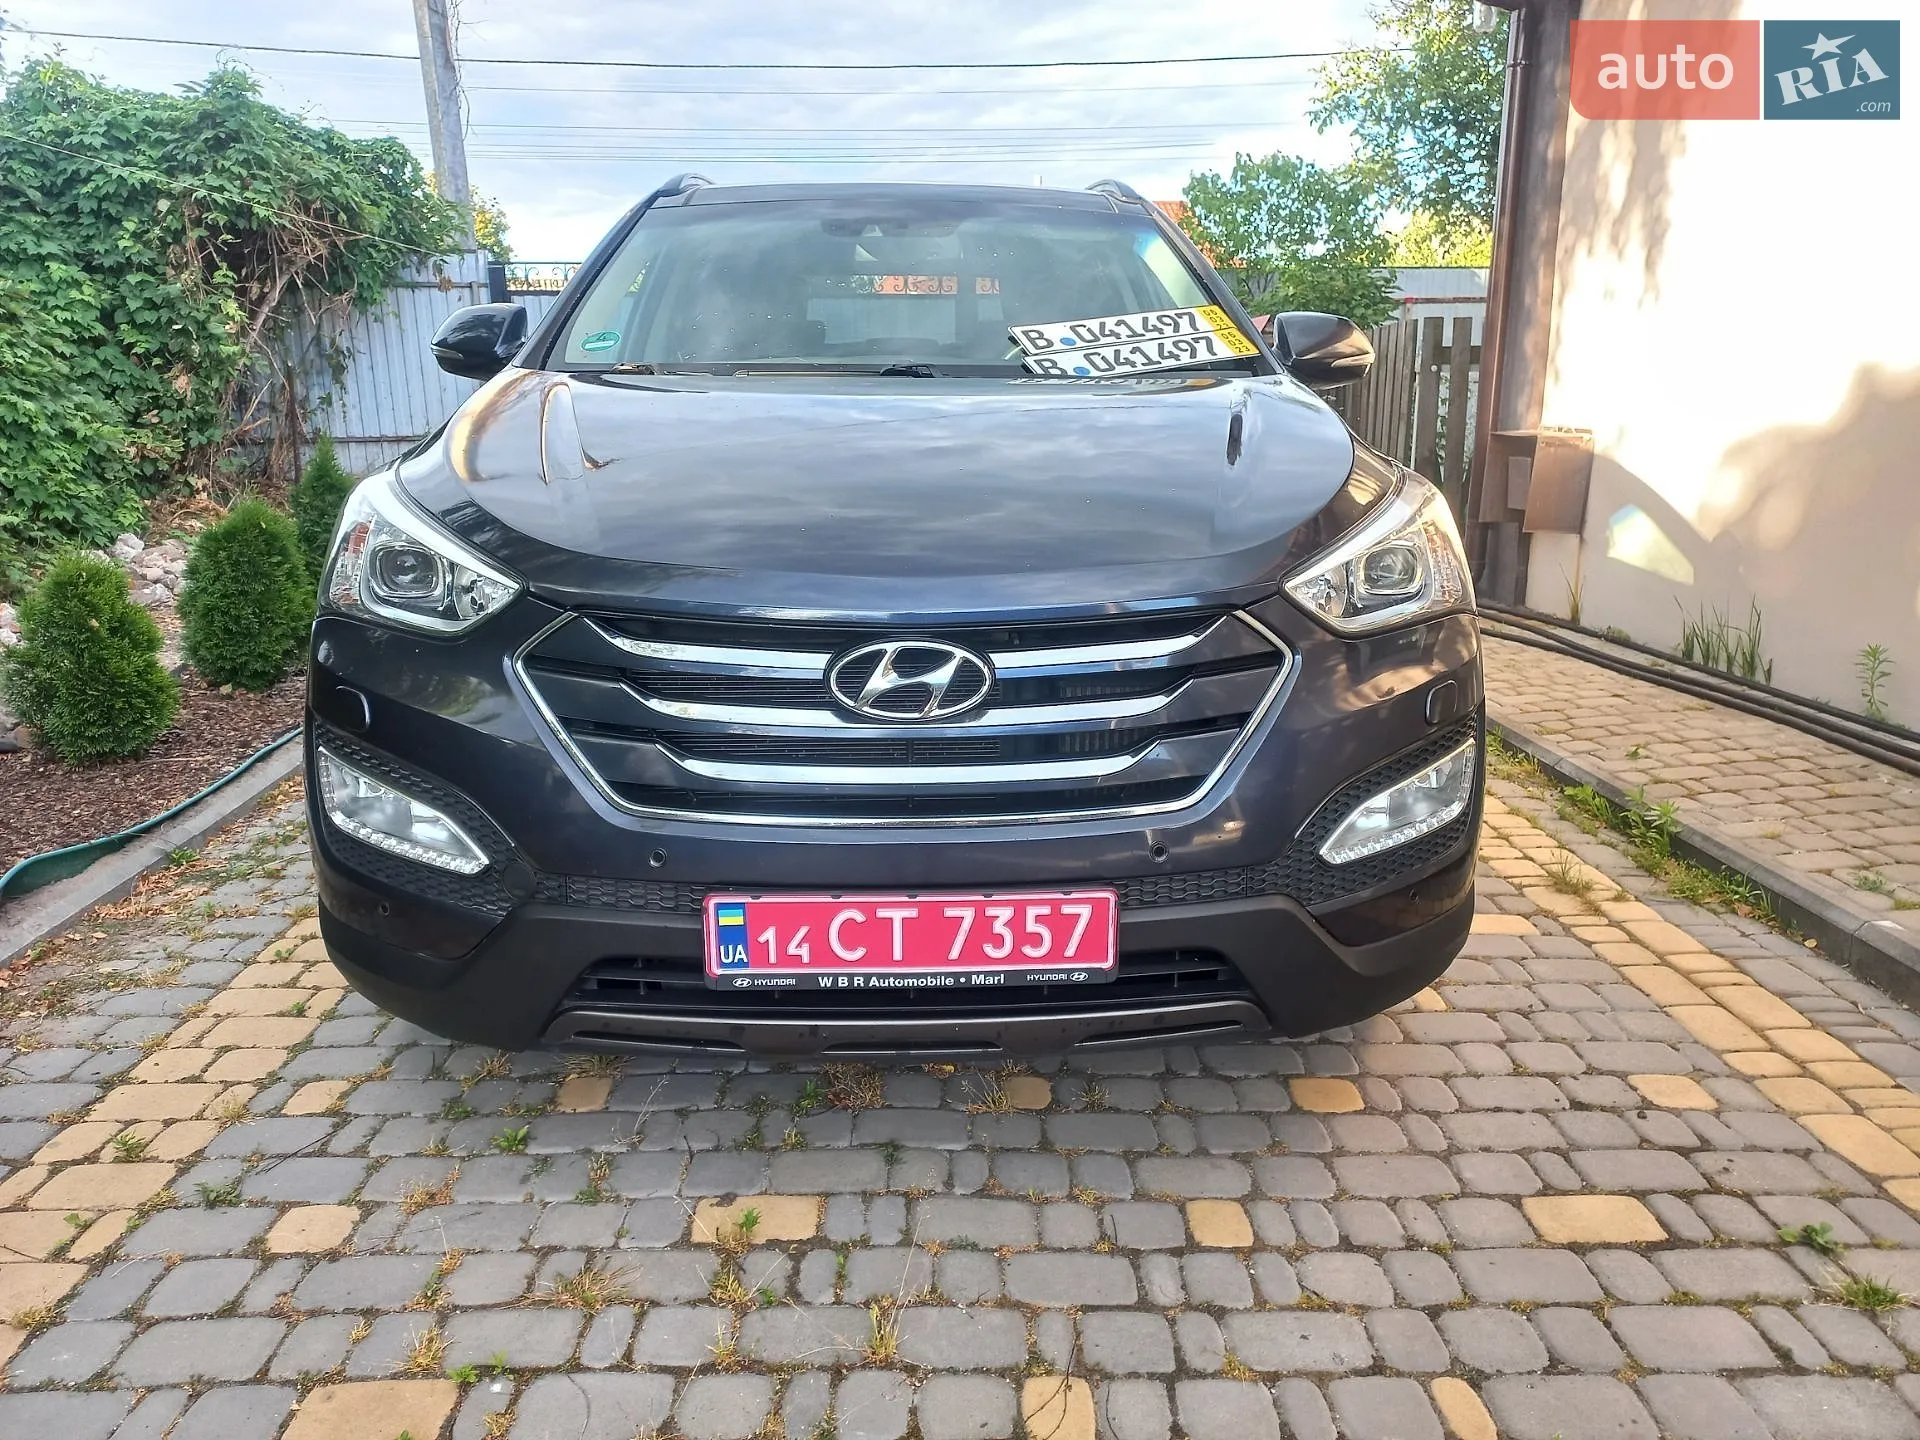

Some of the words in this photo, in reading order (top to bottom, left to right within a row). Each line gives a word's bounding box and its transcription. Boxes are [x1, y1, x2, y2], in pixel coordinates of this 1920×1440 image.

[1021, 329, 1054, 352] B
[1069, 311, 1199, 344] 041497
[1034, 357, 1069, 375] B
[1083, 336, 1218, 372] 041497
[720, 944, 748, 964] UA
[755, 925, 811, 964] 14
[828, 907, 919, 962] CT
[943, 904, 1093, 960] 7357
[754, 978, 796, 986] HYUNDAI
[868, 974, 955, 987] Automobile
[971, 973, 1005, 986] Marl
[1027, 973, 1067, 981] HYUNDAI
